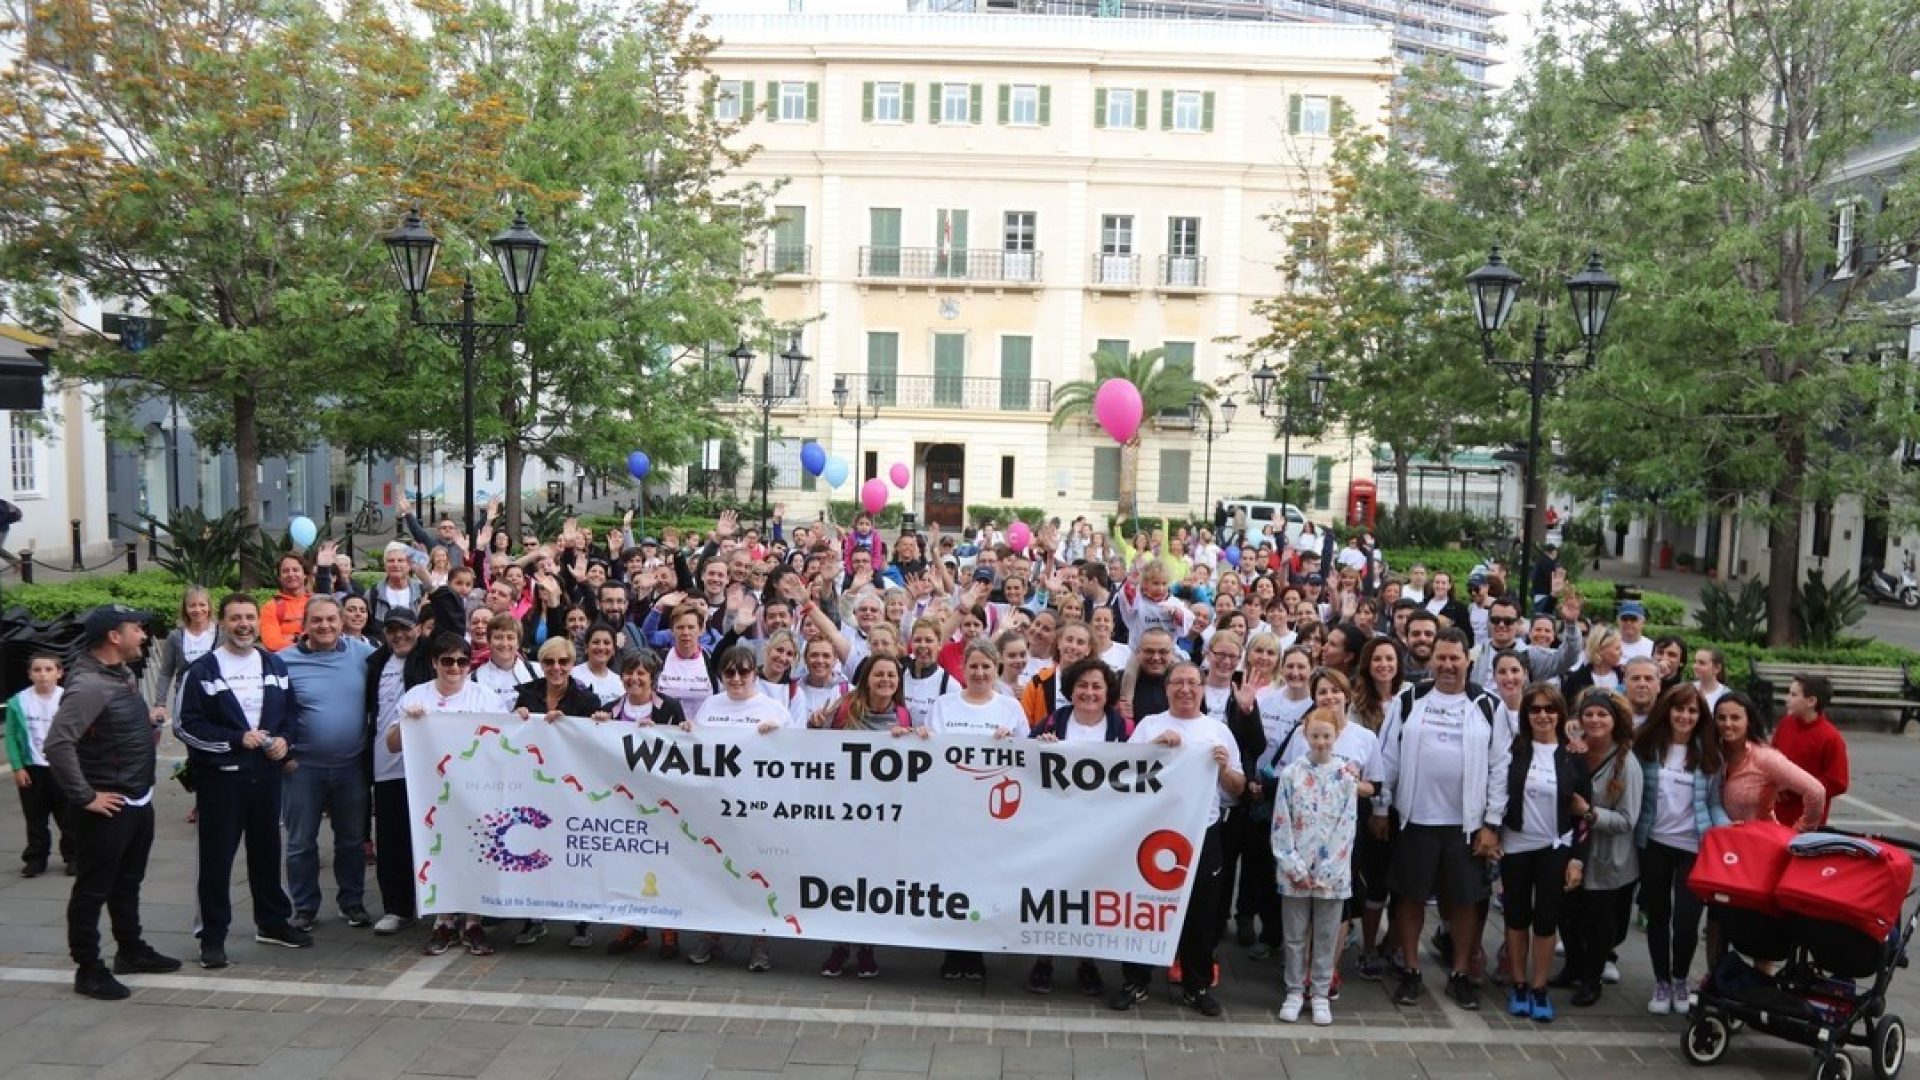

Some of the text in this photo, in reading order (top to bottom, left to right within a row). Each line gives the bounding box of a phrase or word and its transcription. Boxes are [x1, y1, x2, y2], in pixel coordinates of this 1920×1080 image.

[622, 733, 1164, 793] WALK TO THE TOP OF THE ROCK
[720, 799, 903, 822] 22ND APRIL 2017
[565, 816, 649, 836] CANCER
[565, 835, 671, 856] RESEARCH
[566, 853, 593, 868] UK
[1021, 930, 1119, 950] STRENGTH
[1124, 935, 1143, 953] IN
